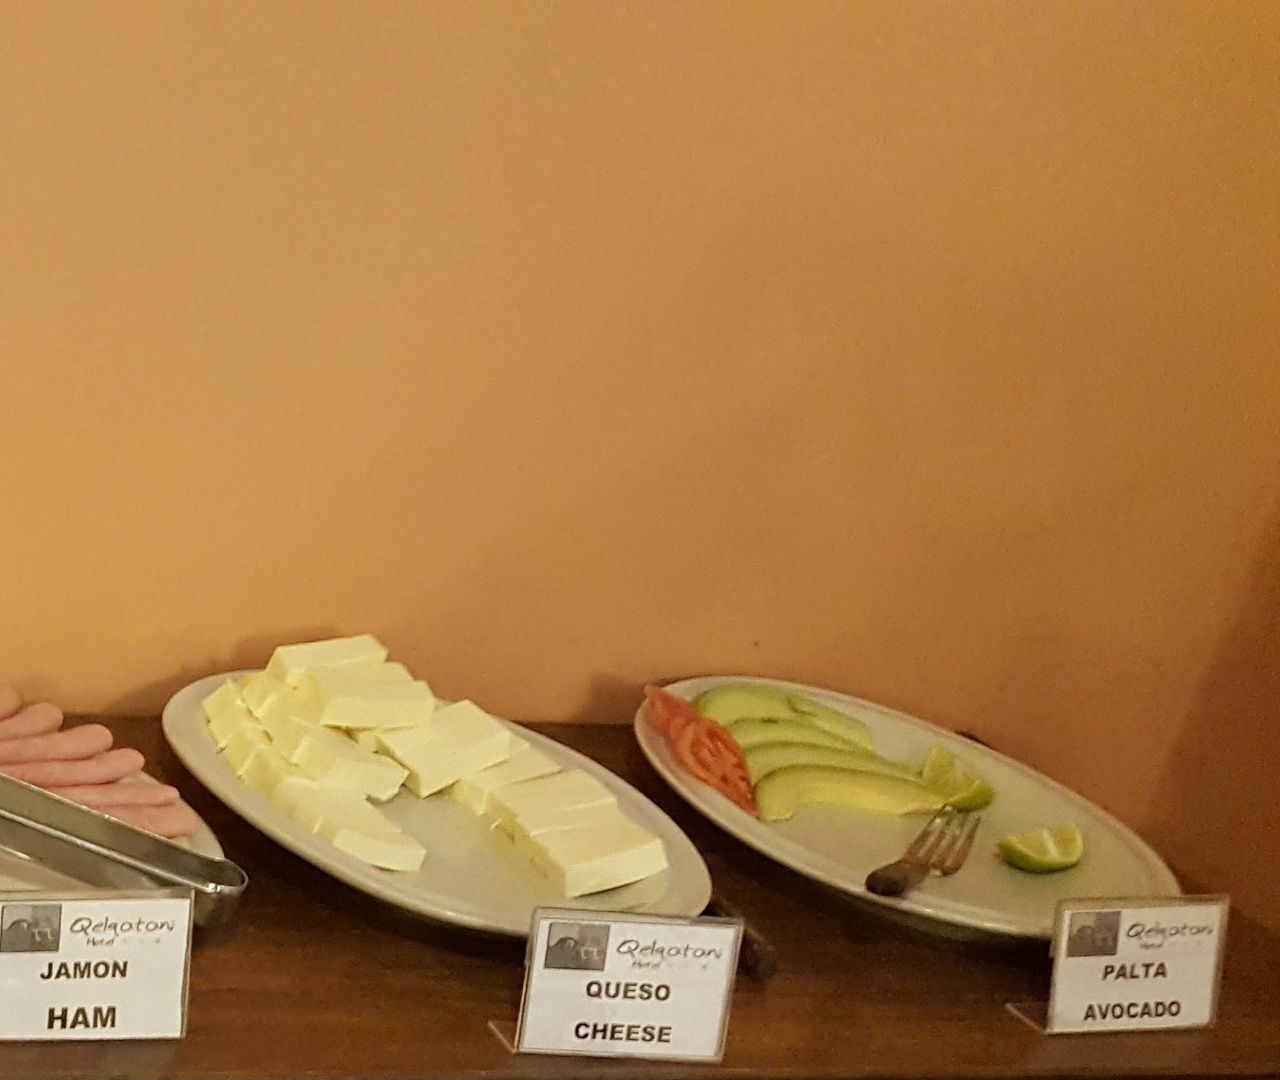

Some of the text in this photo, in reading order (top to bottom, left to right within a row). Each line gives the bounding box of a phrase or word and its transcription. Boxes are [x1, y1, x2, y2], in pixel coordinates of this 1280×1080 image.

[40, 961, 128, 980] JAMON
[1102, 962, 1167, 980] PALTA
[586, 981, 671, 1001] QUESO
[47, 1006, 117, 1029] HAM
[1084, 1001, 1181, 1021] AVOCADO
[574, 1022, 672, 1043] CHEESE
